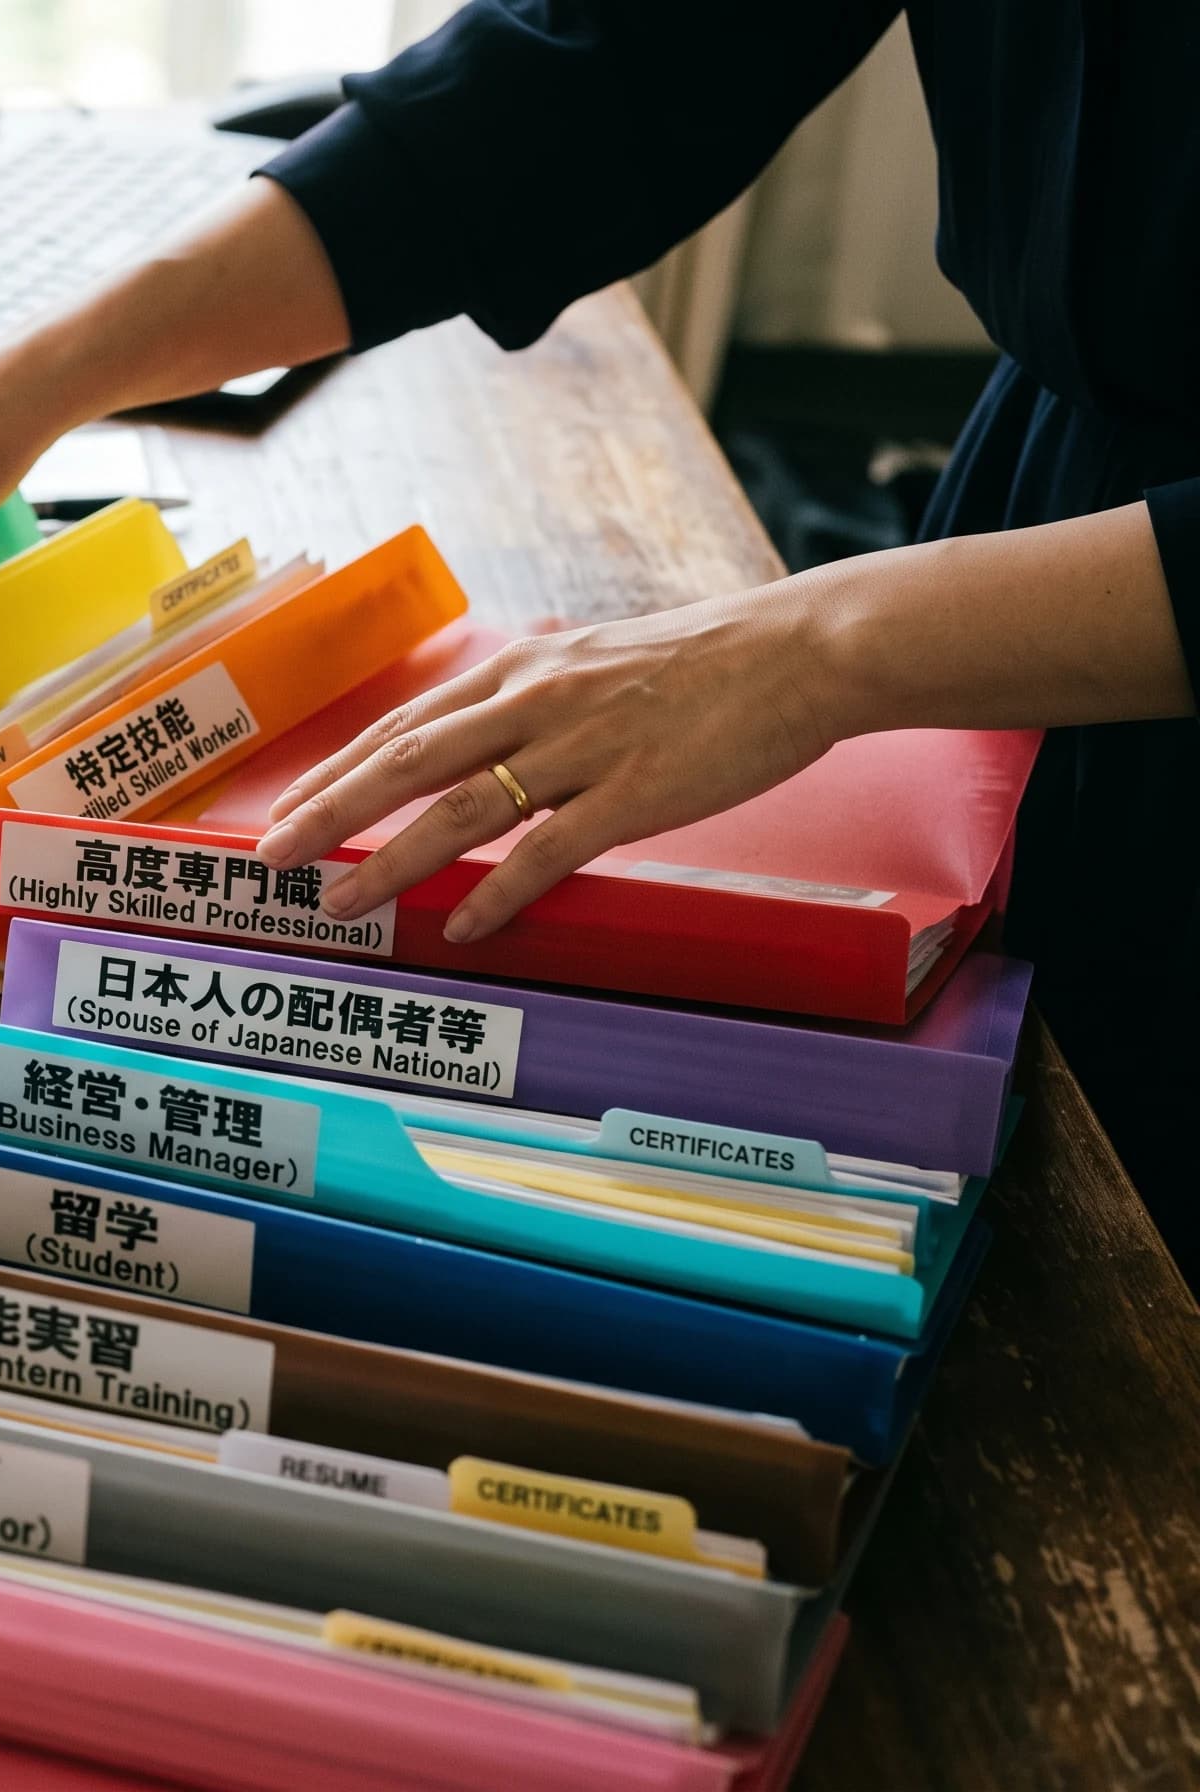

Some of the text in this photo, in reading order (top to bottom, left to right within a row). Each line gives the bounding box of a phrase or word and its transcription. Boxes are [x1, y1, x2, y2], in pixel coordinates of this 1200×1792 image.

[65, 697, 196, 796] 特定技能
[129, 748, 188, 796] Skilled
[184, 708, 252, 764] Worker)
[75, 839, 322, 911] 高度専門職
[9, 874, 383, 950] (Highly Skilled Professional)
[98, 956, 488, 1055] 日本人の配偶者等
[67, 996, 502, 1090] (Spouse of Japanese National)
[22, 1058, 265, 1148] 経営・管理
[148, 1135, 299, 1188] Manager)
[629, 1126, 796, 1172] CERTIFICATES
[50, 1188, 159, 1252] 留学
[26, 1233, 180, 1294] (Student)
[96, 1371, 252, 1432] Training)
[280, 1455, 388, 1498] RESUME
[477, 1478, 663, 1534] CERTIFICATES
